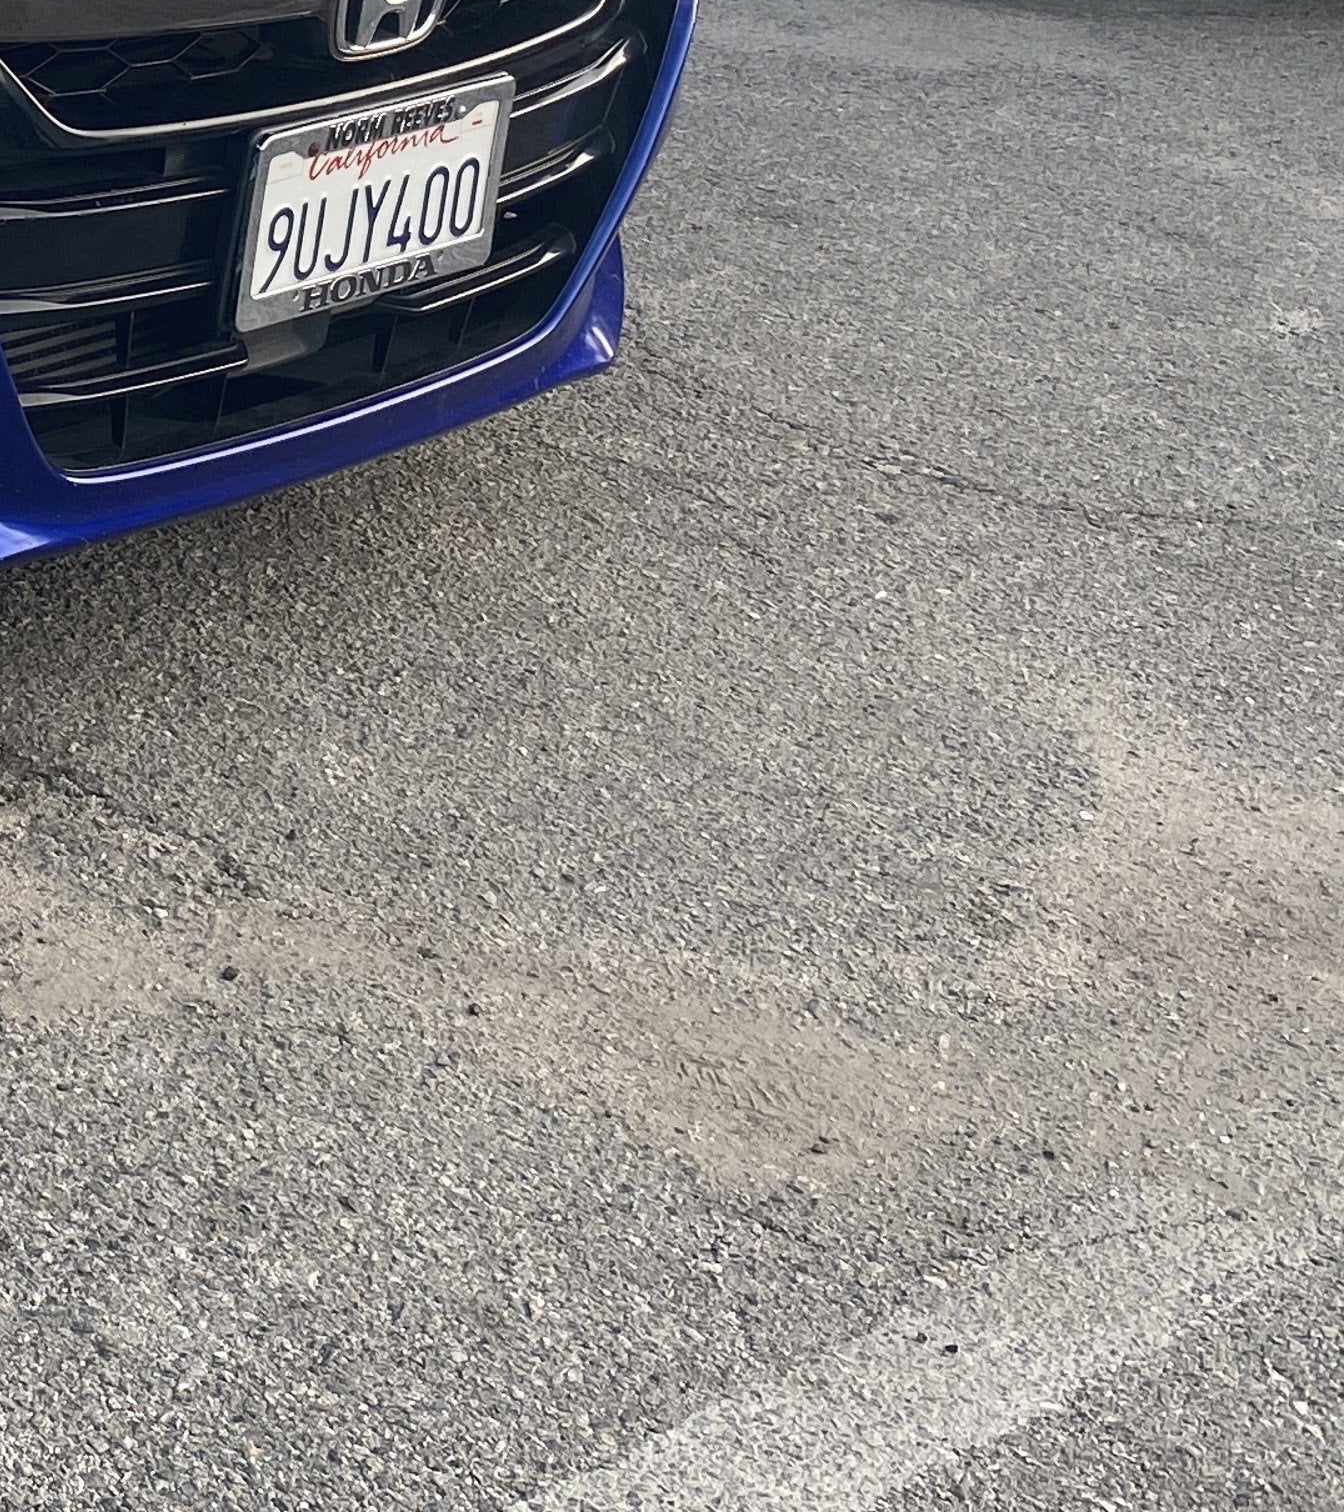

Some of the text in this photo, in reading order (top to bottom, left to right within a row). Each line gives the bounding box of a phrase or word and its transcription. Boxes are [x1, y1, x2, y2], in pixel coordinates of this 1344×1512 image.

[326, 95, 456, 152] NORM REEVES
[308, 125, 459, 181] California
[258, 157, 480, 294] 9UJY400
[297, 254, 437, 312] HONDA
